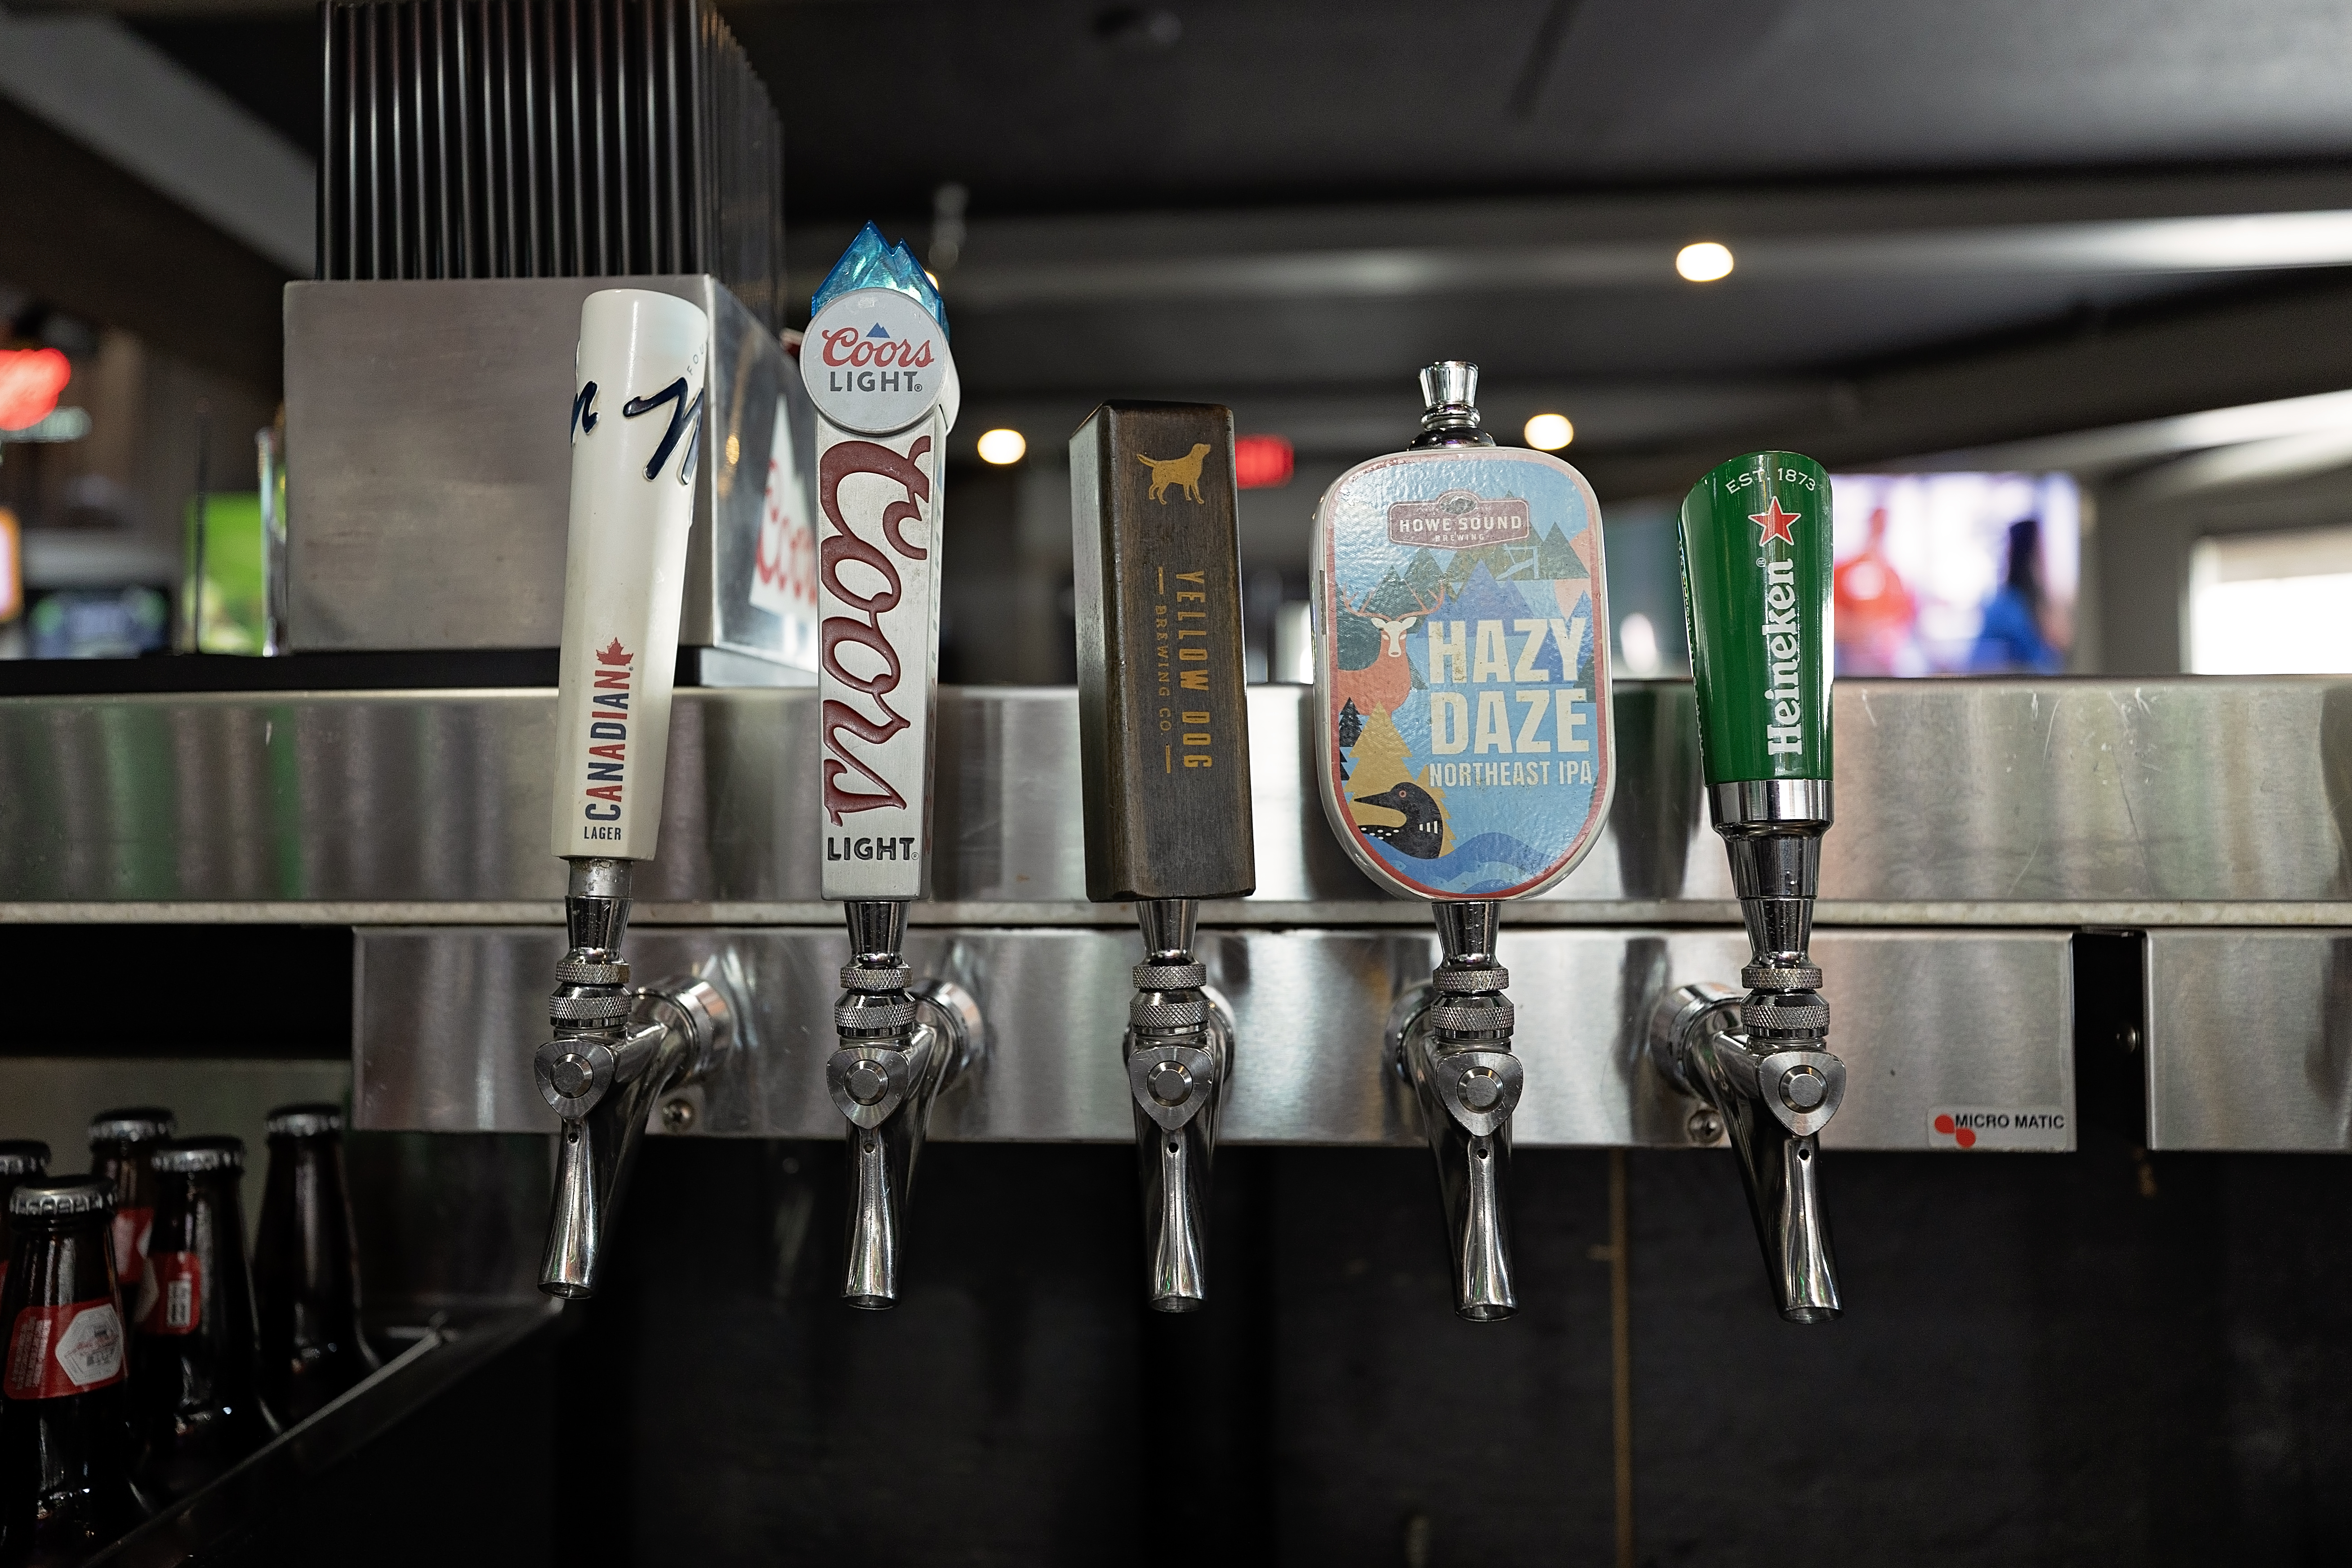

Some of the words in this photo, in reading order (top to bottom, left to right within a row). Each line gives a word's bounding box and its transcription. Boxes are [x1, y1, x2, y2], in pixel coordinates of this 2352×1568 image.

[822, 327, 934, 367] Coors
[1777, 468, 1816, 491] 1873
[1399, 518, 1452, 532] HOWE
[1459, 516, 1522, 530] SOUND
[1435, 533, 1485, 542] BREWING
[820, 436, 931, 827] Coors
[1155, 605, 1170, 696] BREWING
[1176, 570, 1209, 690] YELLOW
[1428, 618, 1586, 684] HAZY
[585, 670, 631, 821] CANADIAN
[1182, 711, 1212, 767] DOG
[1430, 689, 1589, 755] DAZE
[1430, 762, 1550, 787] NORTHEAST
[1559, 760, 1592, 785] IPA
[584, 826, 621, 840] LAGER
[1956, 1114, 2009, 1128] MICRO
[2015, 1114, 2064, 1129] MATIC
